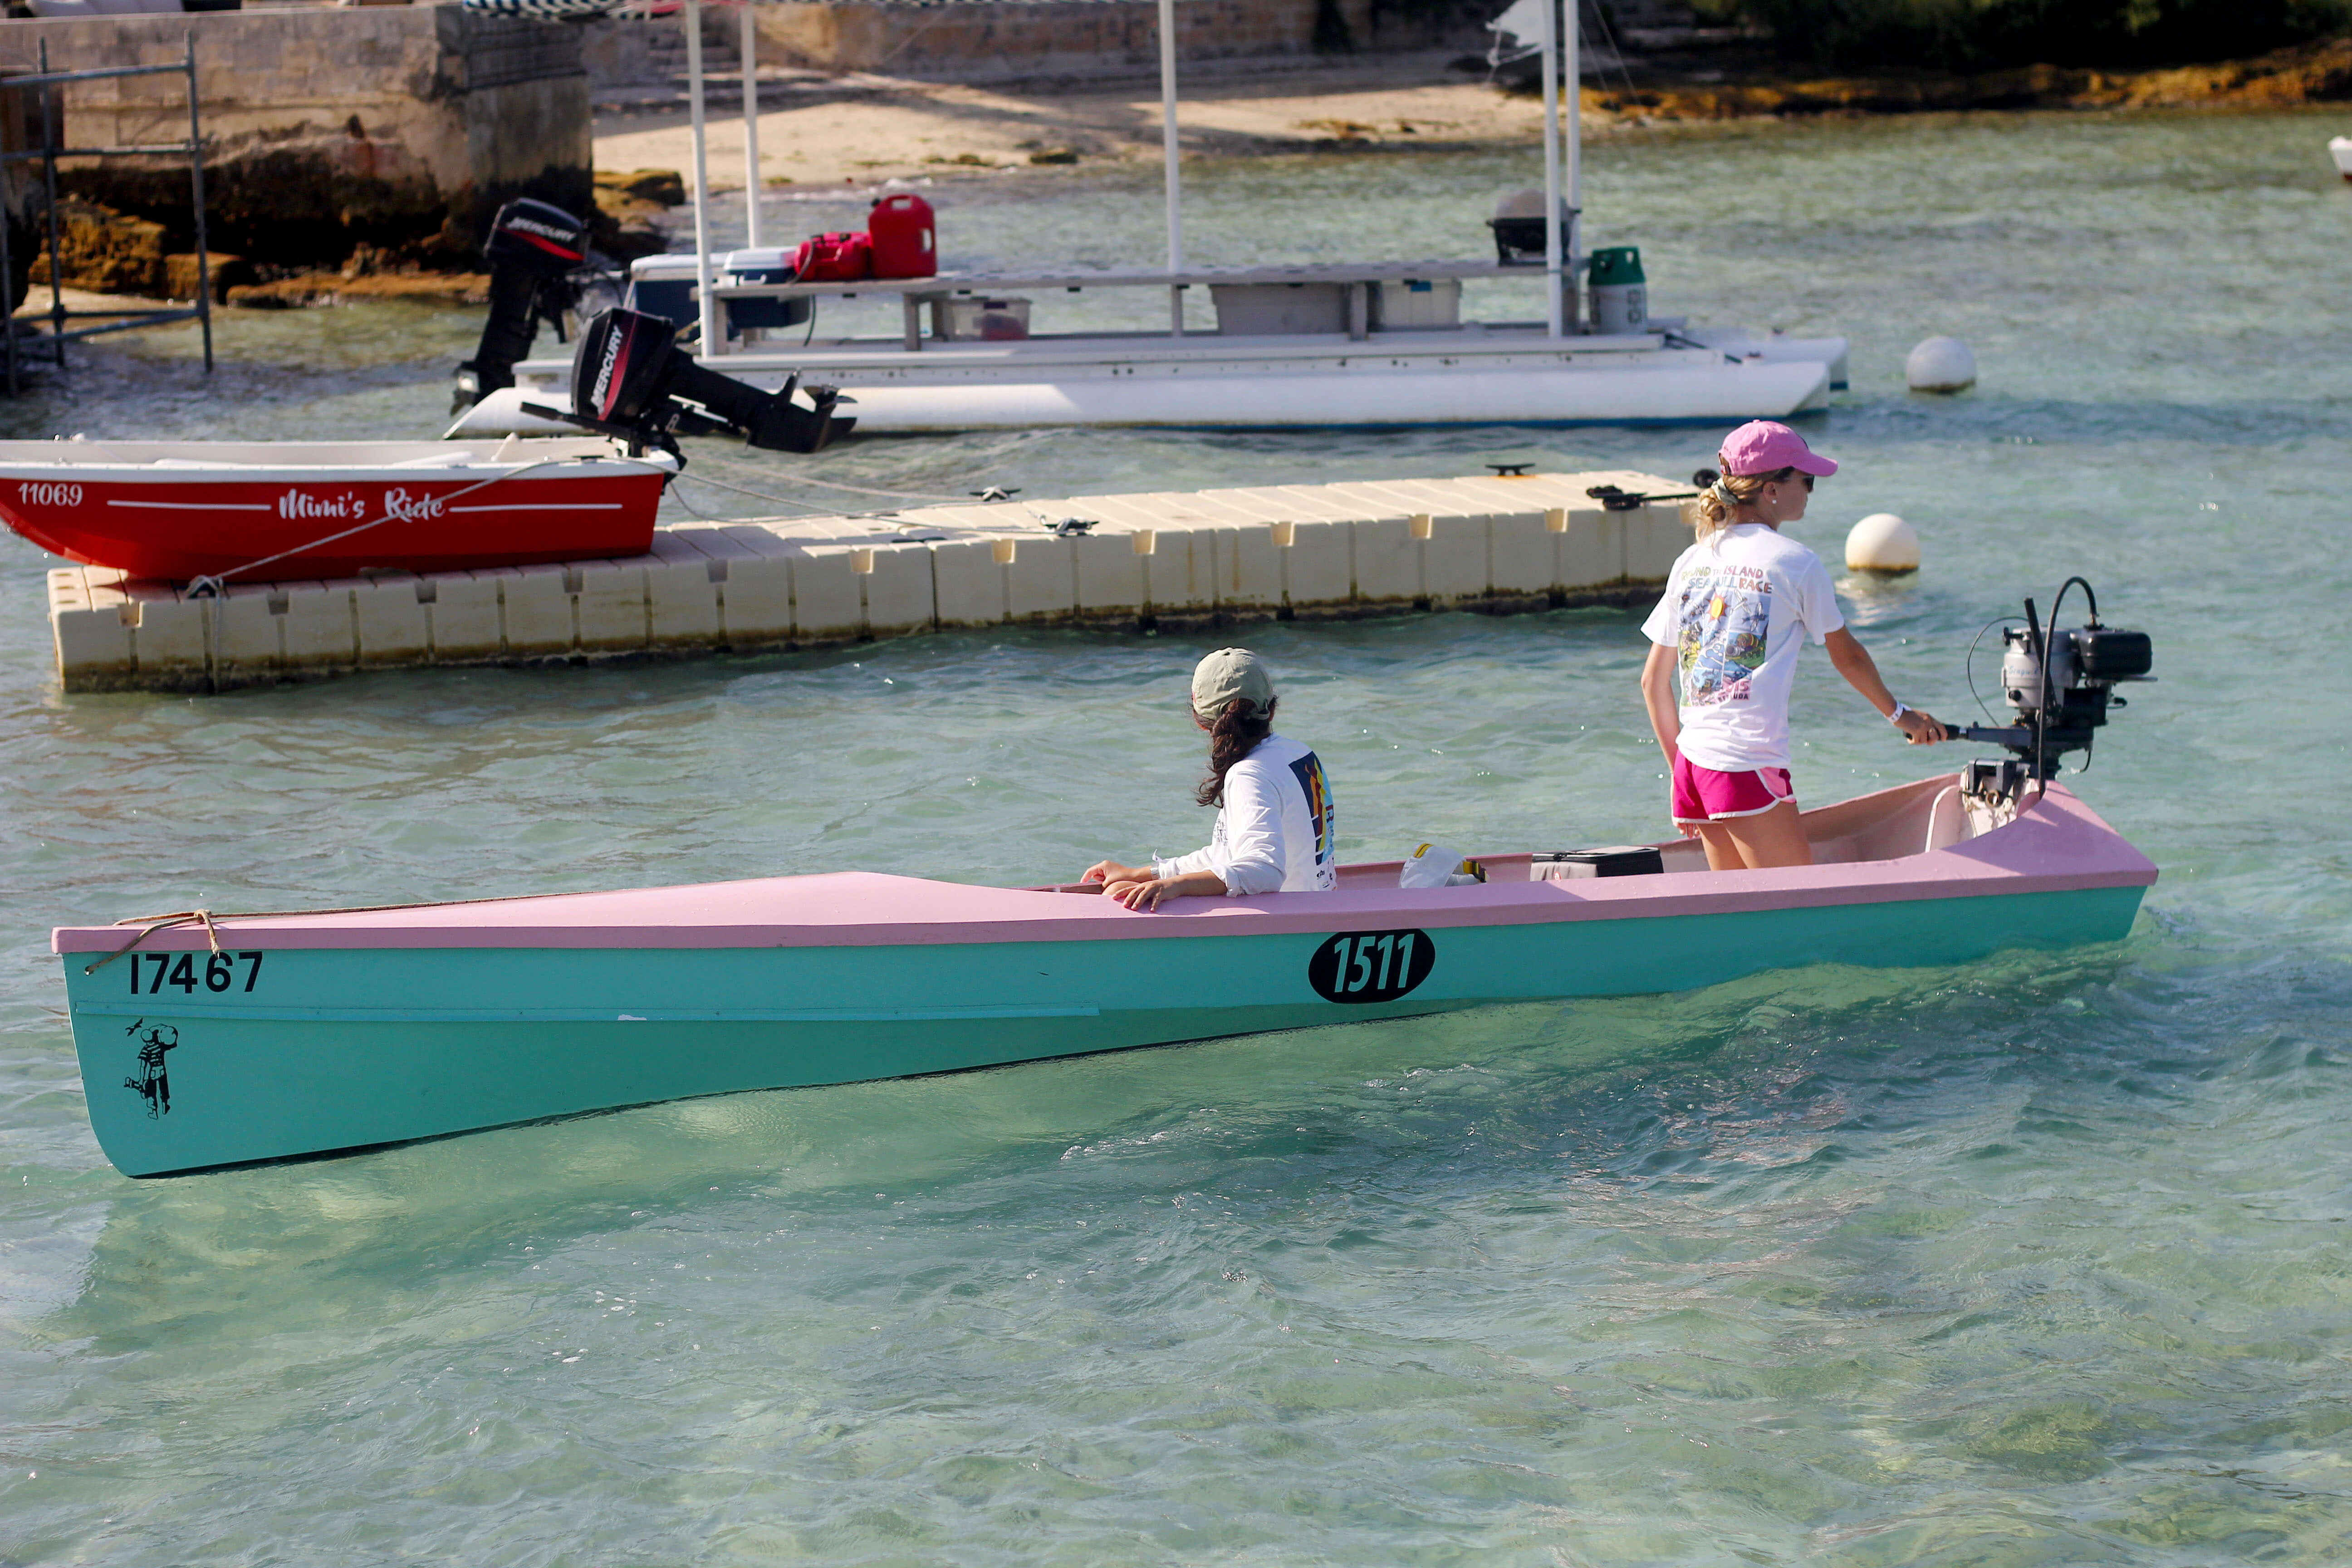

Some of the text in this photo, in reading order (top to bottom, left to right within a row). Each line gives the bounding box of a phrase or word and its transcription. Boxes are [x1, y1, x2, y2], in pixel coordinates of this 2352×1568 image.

[506, 217, 577, 241] MERCURY
[591, 324, 623, 415] MERCURY
[18, 482, 83, 507] 11069
[279, 487, 446, 523] Mimi's Ride
[1688, 576, 1773, 593] SEAULL RACE
[1725, 566, 1764, 578] ISLAND
[131, 951, 263, 994] 17467
[1334, 933, 1415, 993] 1511
